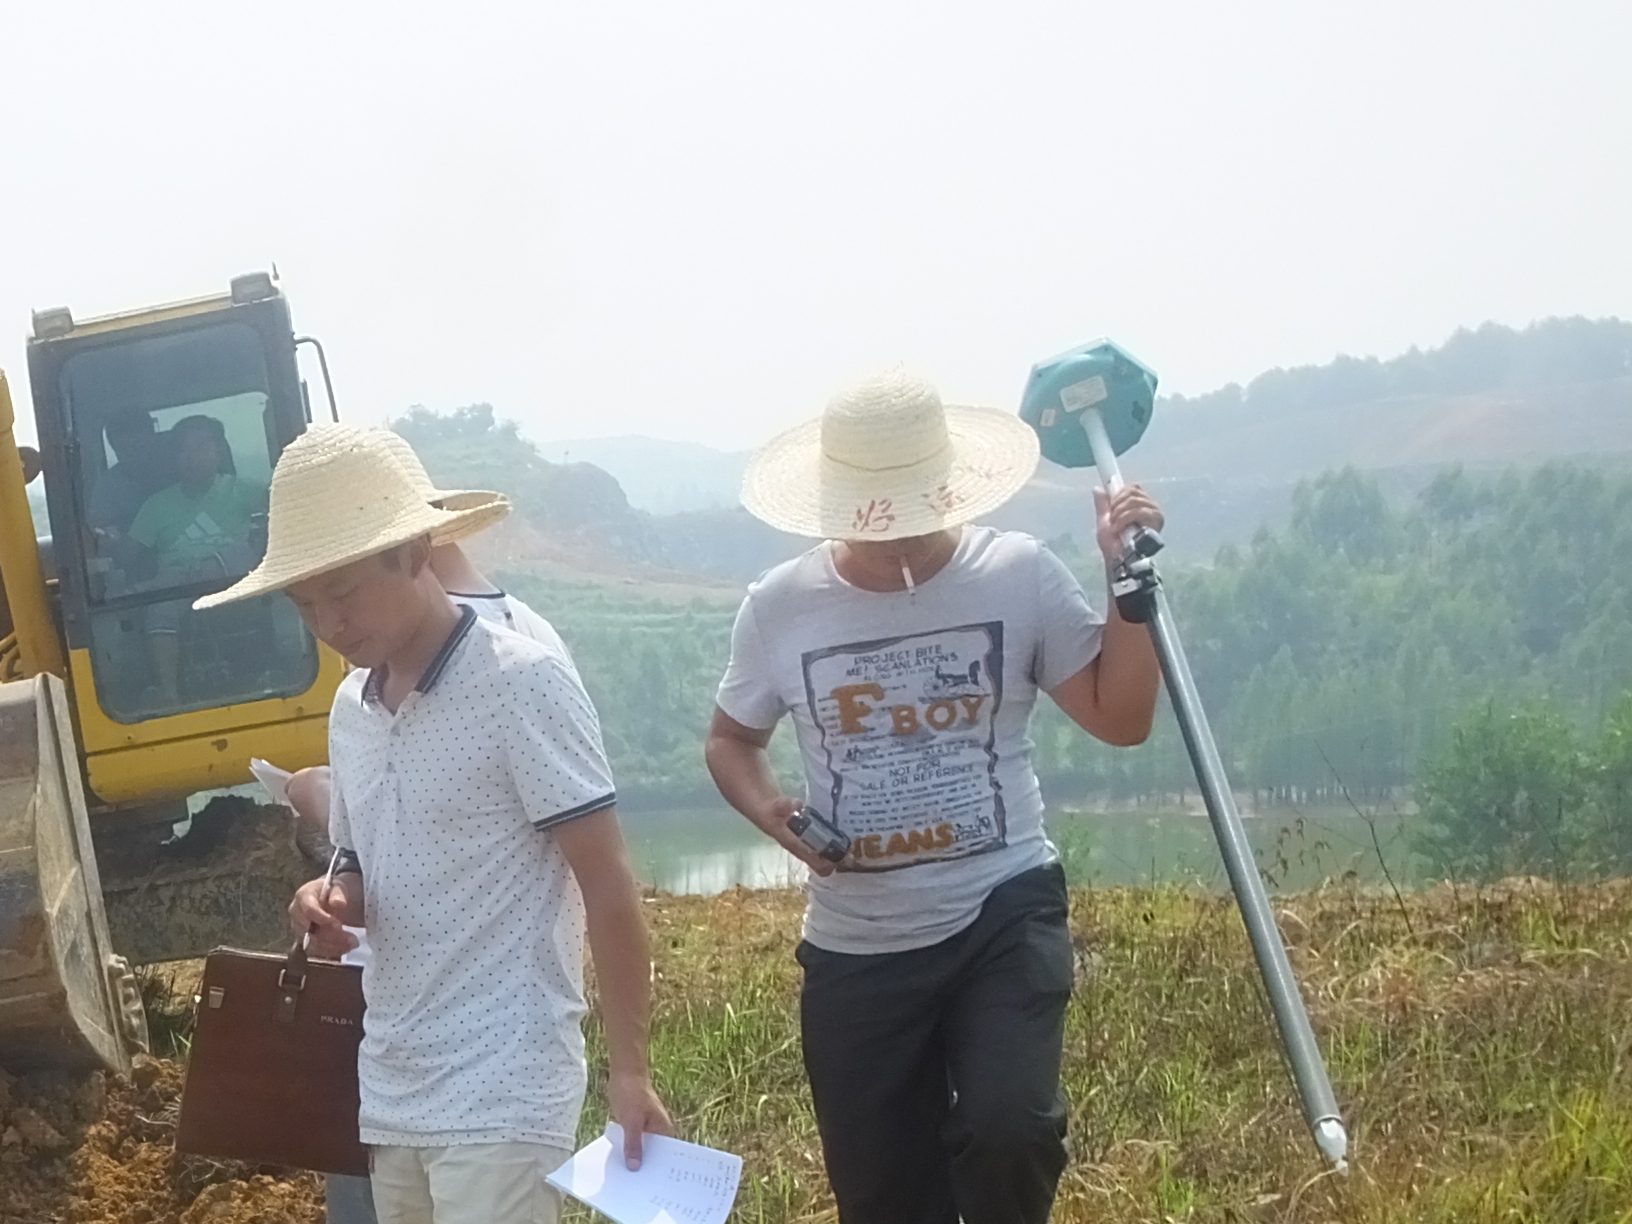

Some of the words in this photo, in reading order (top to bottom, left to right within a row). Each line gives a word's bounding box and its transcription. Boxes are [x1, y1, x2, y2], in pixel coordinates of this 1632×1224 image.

[854, 650, 910, 665] PROJECT
[915, 644, 942, 658] BITE
[889, 766, 910, 777] NOT
[860, 779, 886, 791] SALE
[892, 776, 908, 788] OR
[320, 1015, 354, 1026] PRADA
